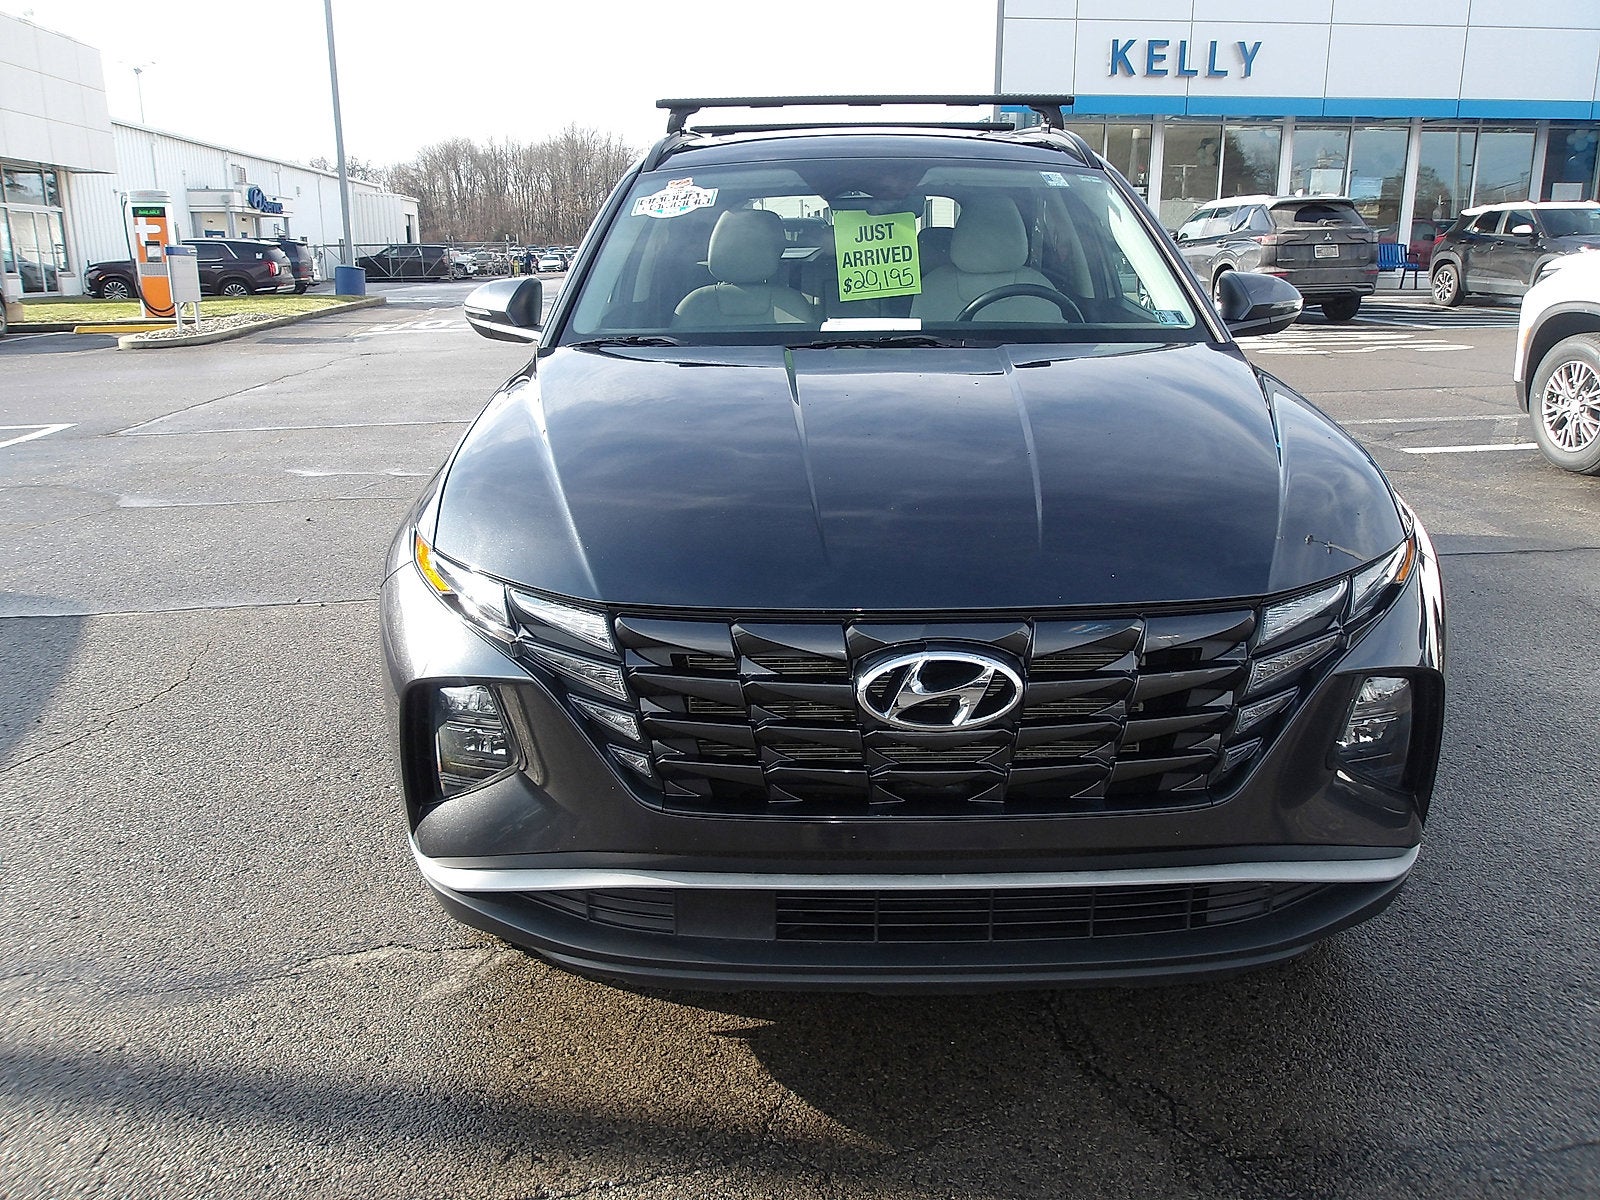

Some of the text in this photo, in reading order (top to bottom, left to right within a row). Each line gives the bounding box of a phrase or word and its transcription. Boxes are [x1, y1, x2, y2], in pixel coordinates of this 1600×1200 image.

[1109, 39, 1262, 78] KELLY
[855, 222, 894, 243] JUST
[842, 245, 913, 268] ARRIVED
